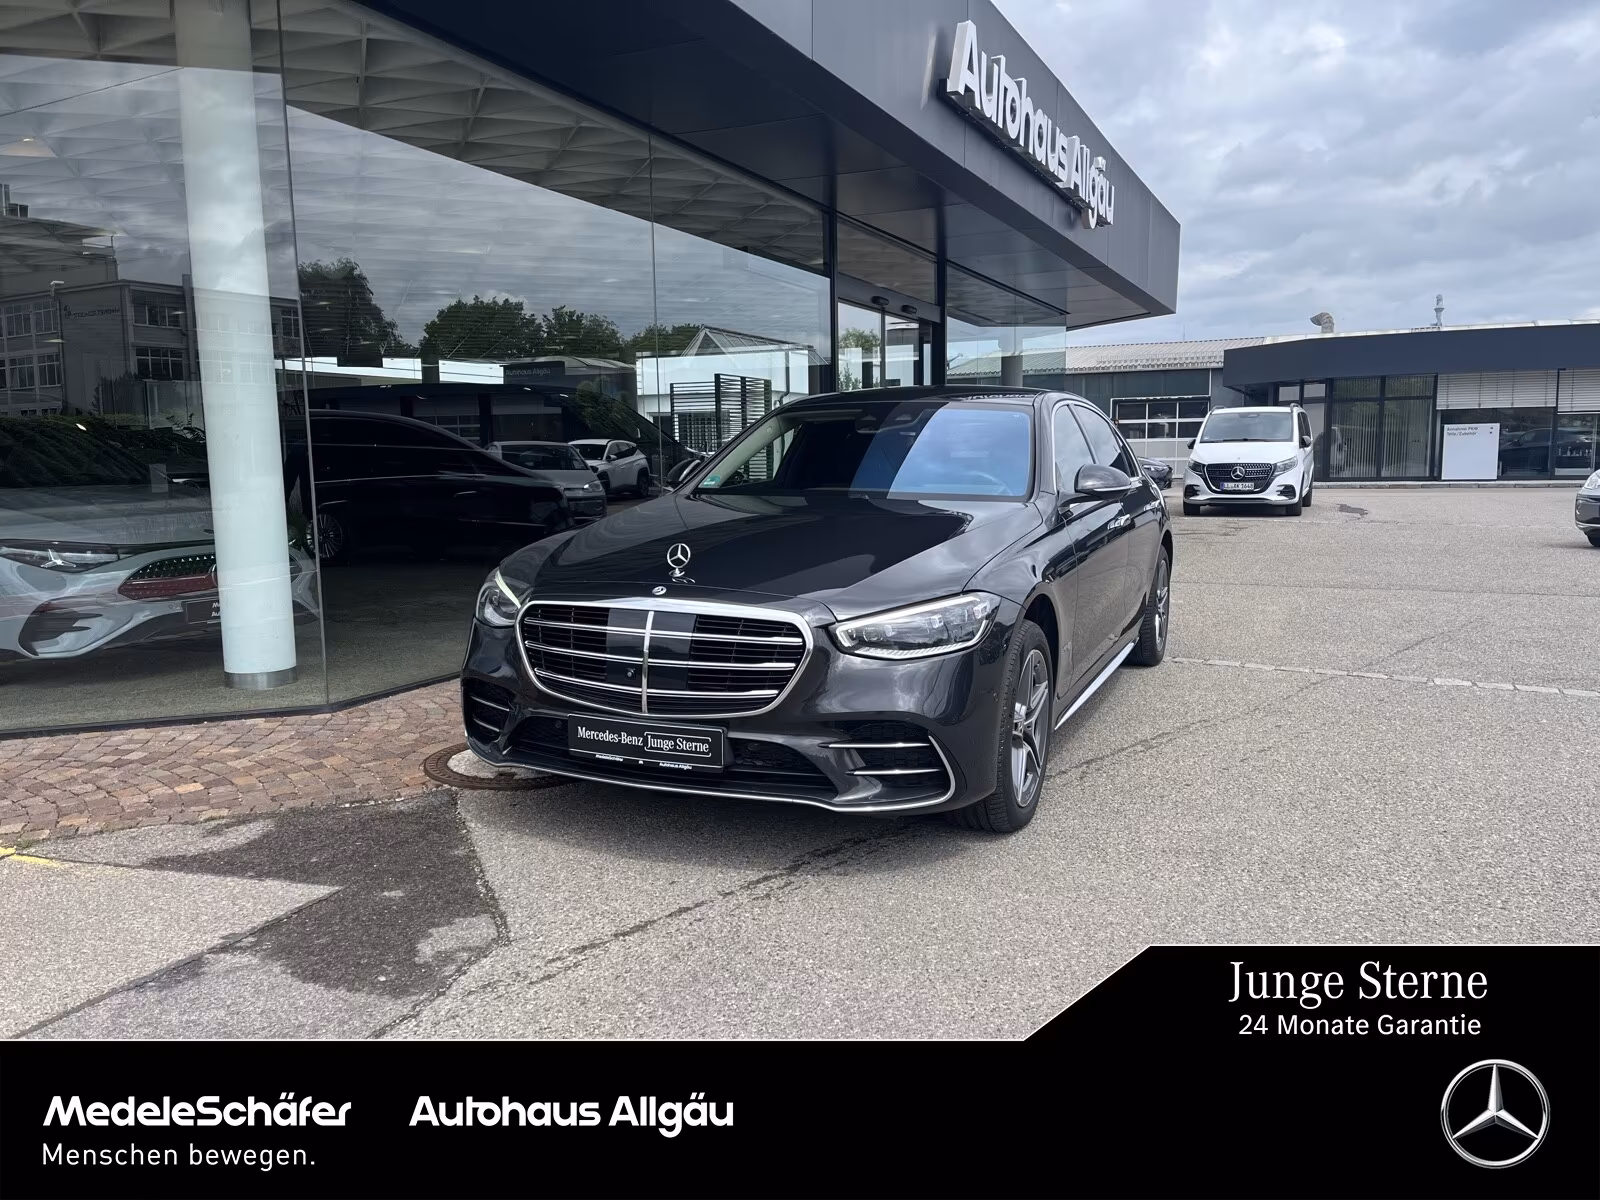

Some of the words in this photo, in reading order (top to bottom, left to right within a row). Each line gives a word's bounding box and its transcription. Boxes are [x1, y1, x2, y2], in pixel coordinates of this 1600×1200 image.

[947, 20, 1067, 183] Autohaus
[1057, 135, 1115, 229] Allgäu
[577, 726, 643, 746] Mercedes-Benz
[647, 735, 674, 751] Junge
[676, 737, 709, 752] Sterne
